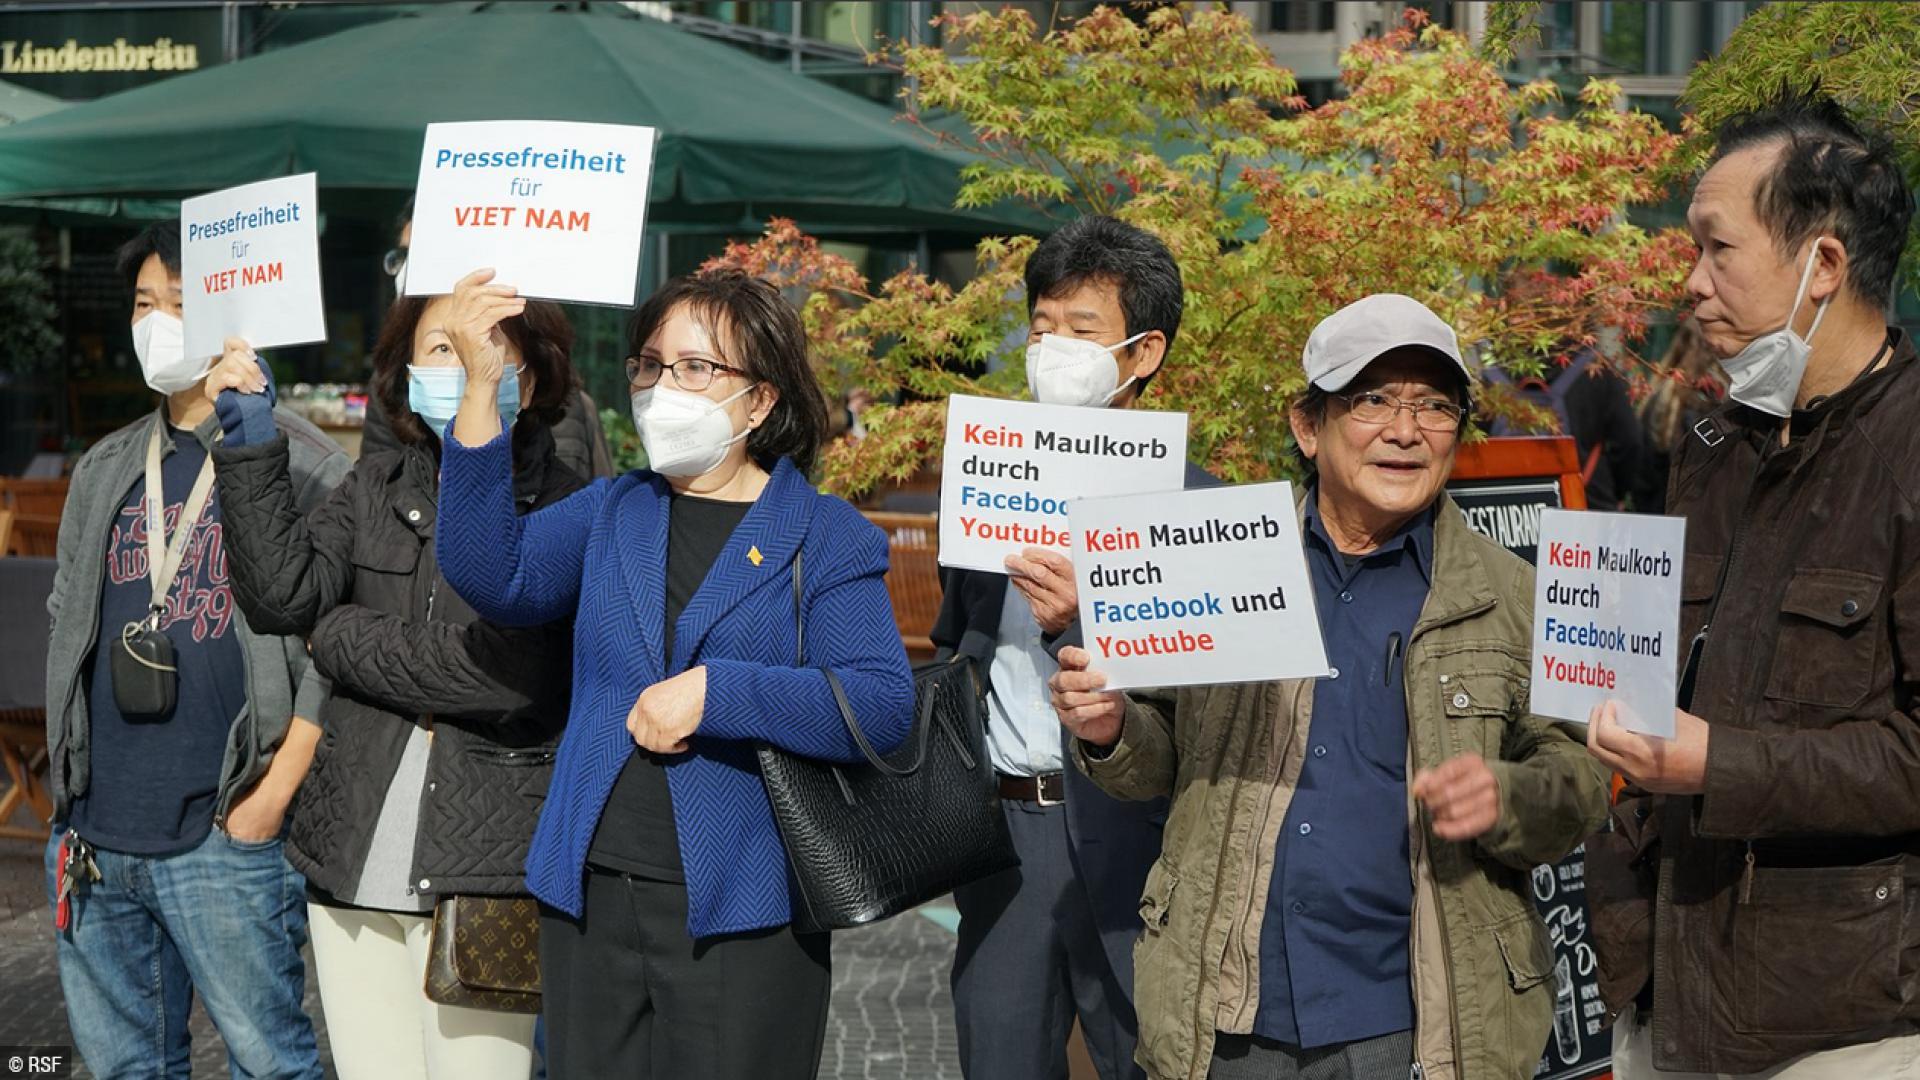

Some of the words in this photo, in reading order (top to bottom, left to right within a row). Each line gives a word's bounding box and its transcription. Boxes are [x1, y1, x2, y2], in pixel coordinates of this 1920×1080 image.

[0, 37, 199, 73] Lindenbräu
[436, 147, 627, 174] Pressefreiheit
[511, 177, 543, 197] für
[189, 202, 300, 242] Pressefreiheit
[455, 206, 517, 227] VIET
[525, 207, 591, 233] NAM
[231, 240, 250, 259] für
[203, 268, 238, 295] VIET
[241, 261, 284, 287] NAM
[964, 423, 1024, 449] Kein
[1034, 429, 1168, 460] Maulkorb
[962, 454, 1040, 482] durch
[960, 516, 1072, 547] Youtube
[1085, 526, 1141, 553] Kein
[1149, 514, 1280, 548] Maulkorb
[1089, 560, 1163, 589] durch
[1550, 541, 1592, 570] Kein
[1597, 546, 1672, 578] Maulkorb
[1093, 592, 1225, 624] Facebook
[1231, 586, 1287, 614] und
[1546, 579, 1601, 609] durch
[1096, 629, 1215, 659] Youtube
[1545, 617, 1627, 653] Facebook
[1630, 630, 1663, 658] und
[1543, 654, 1617, 690] Youtube
